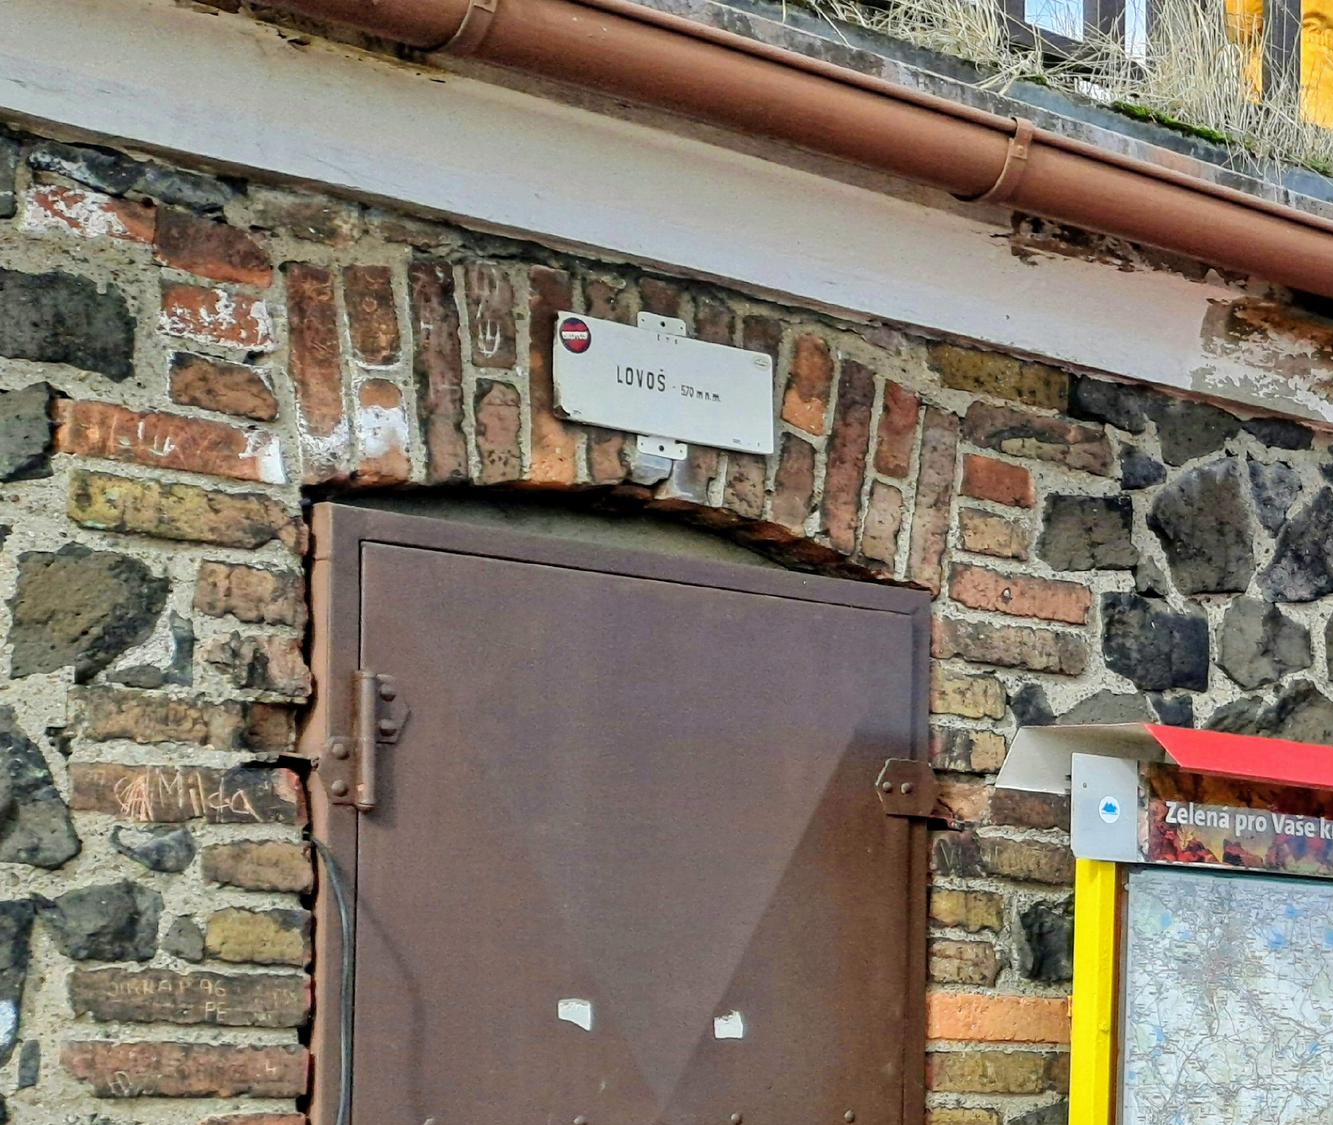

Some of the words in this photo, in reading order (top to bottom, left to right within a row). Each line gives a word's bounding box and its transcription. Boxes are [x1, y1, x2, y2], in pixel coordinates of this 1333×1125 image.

[616, 365, 666, 392] LOVOŠ
[1165, 801, 1231, 829] Zelená
[1236, 812, 1268, 837] pro
[1271, 812, 1317, 838] Vaše
